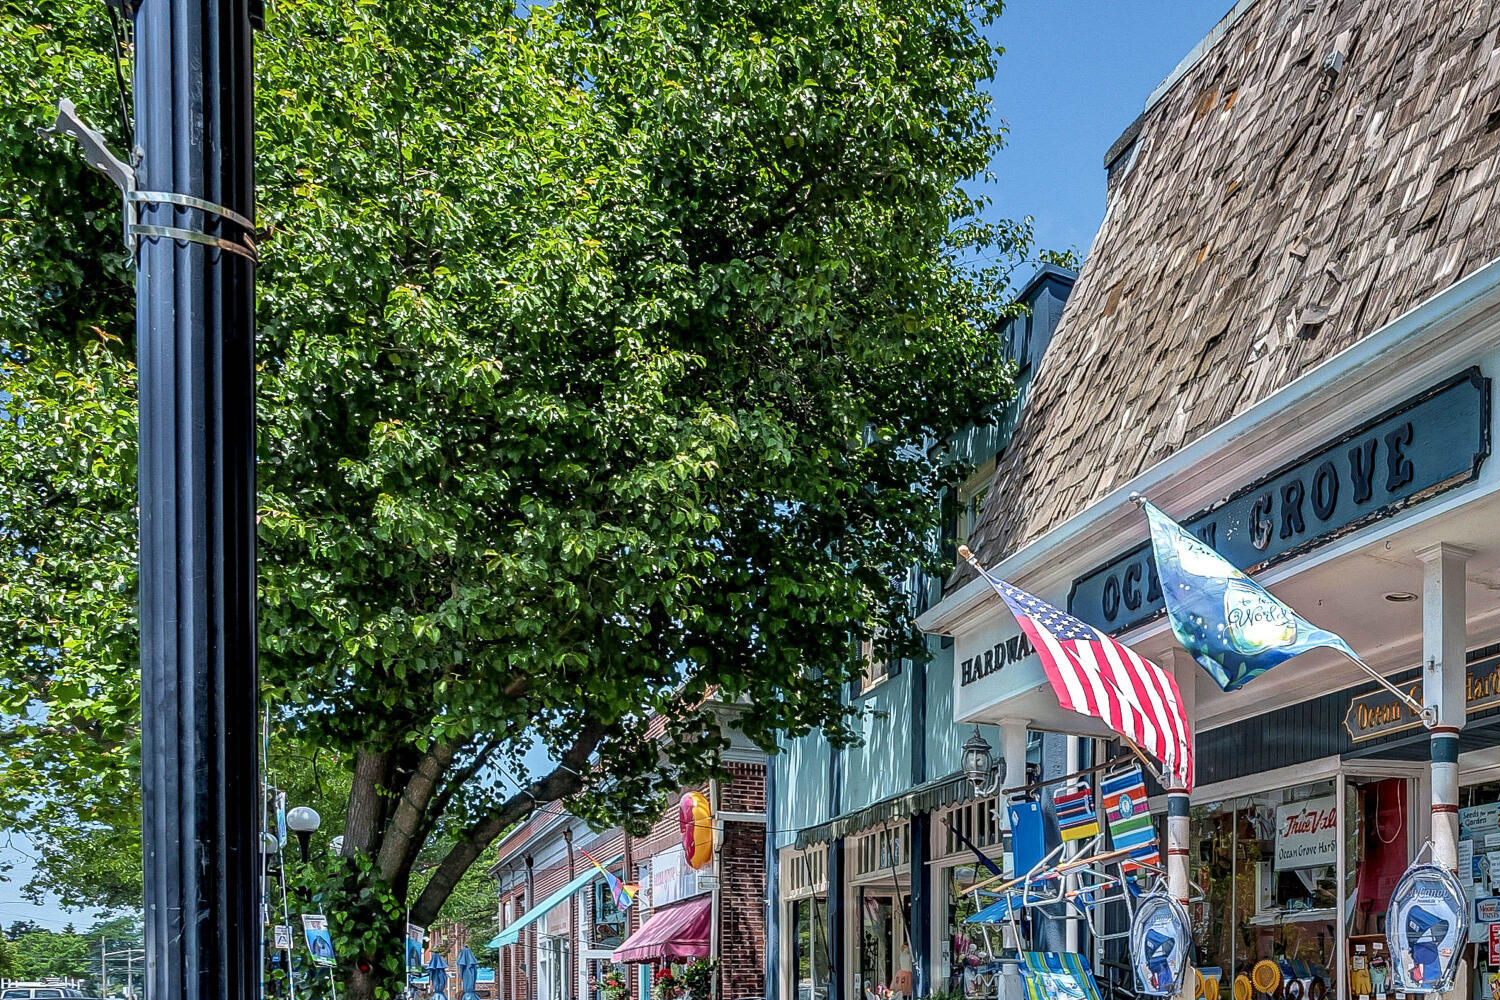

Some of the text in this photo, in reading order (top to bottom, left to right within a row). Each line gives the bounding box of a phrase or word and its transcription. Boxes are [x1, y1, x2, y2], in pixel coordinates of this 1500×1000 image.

[1247, 421, 1415, 551] GROVE
[1228, 604, 1292, 627] World
[961, 631, 1037, 687] HARDWA
[1358, 700, 1400, 730] Ocean
[1284, 807, 1336, 837] True Val
[1463, 810, 1479, 819] Seeds
[1464, 817, 1487, 827] Garden
[1279, 840, 1336, 860] Ocean Grove Hard
